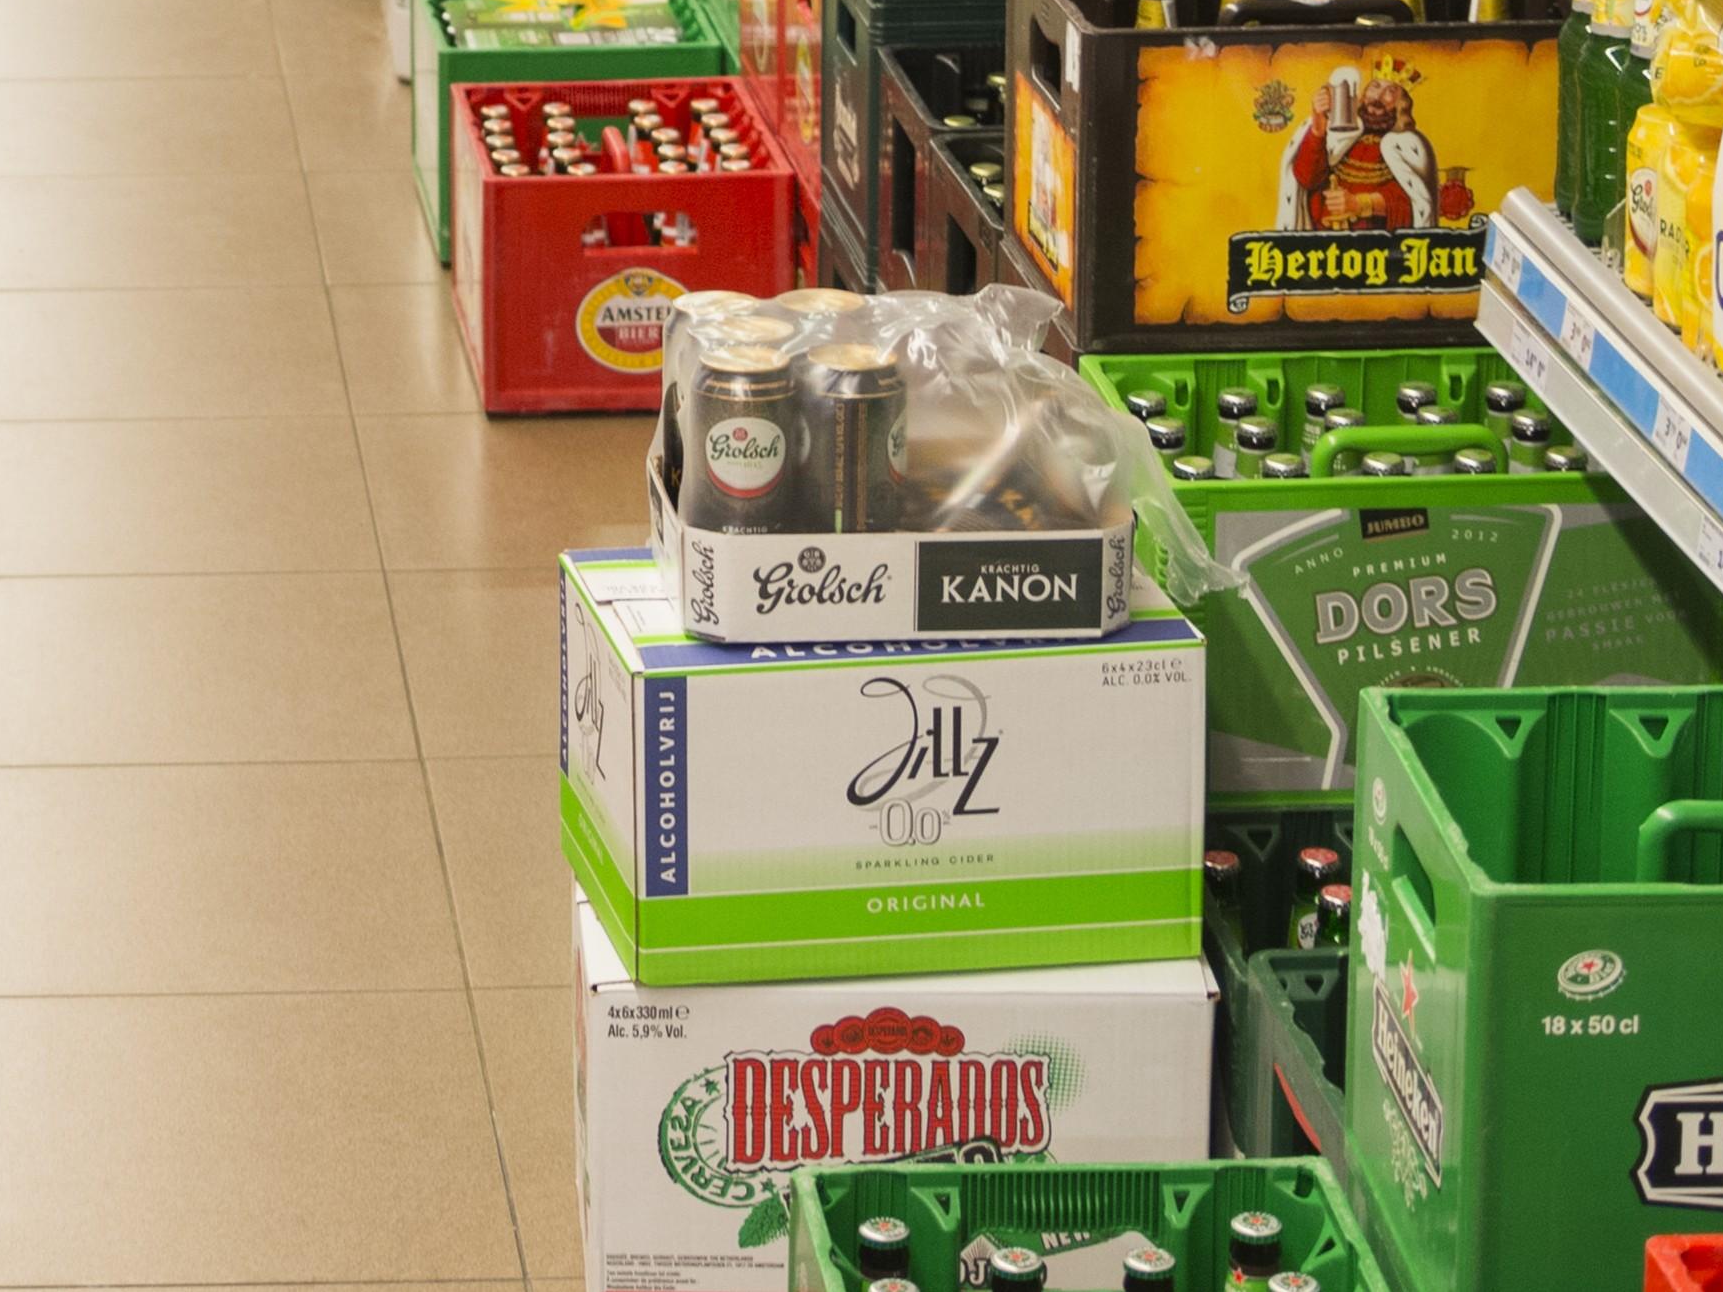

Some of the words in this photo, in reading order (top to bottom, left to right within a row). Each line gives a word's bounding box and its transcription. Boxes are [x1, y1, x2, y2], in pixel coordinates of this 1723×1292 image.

[1245, 240, 1389, 285] Hertog
[1399, 240, 1478, 285] Jan
[617, 324, 662, 343] BIER
[710, 429, 780, 463] Grolsch
[1365, 514, 1425, 535] JUMBO
[1451, 528, 1500, 542] 2012
[981, 565, 1040, 574] KRACHTIG
[1294, 547, 1344, 575] ANNO
[1352, 553, 1447, 577] PREMIUM
[690, 544, 719, 625] Grolsch
[753, 563, 889, 615] Grolsch
[942, 575, 1077, 603] KANON
[1106, 534, 1126, 621] Grolsch
[1314, 568, 1497, 644] DORS
[1338, 627, 1481, 665] PILSENER
[1102, 674, 1128, 687] ALC.
[1132, 672, 1160, 685] 0.0%
[1165, 670, 1191, 682] VOL.
[660, 689, 678, 884] ALCOHOLVRIJ
[855, 857, 941, 870] SPARKLING
[948, 852, 995, 866] CIDER
[867, 891, 987, 914] ORIGINAL
[608, 1024, 629, 1039] Alc.
[632, 1024, 662, 1039] 5,9%
[665, 1023, 687, 1039] Vol.
[1541, 1016, 1566, 1035] 18
[1570, 1020, 1583, 1034] x
[1587, 1015, 1615, 1035] 50
[1619, 1015, 1638, 1035] cl
[1374, 995, 1441, 1184] Heineken
[732, 1058, 1044, 1164] DESPERADOS
[661, 1095, 755, 1202] CERVEZA
